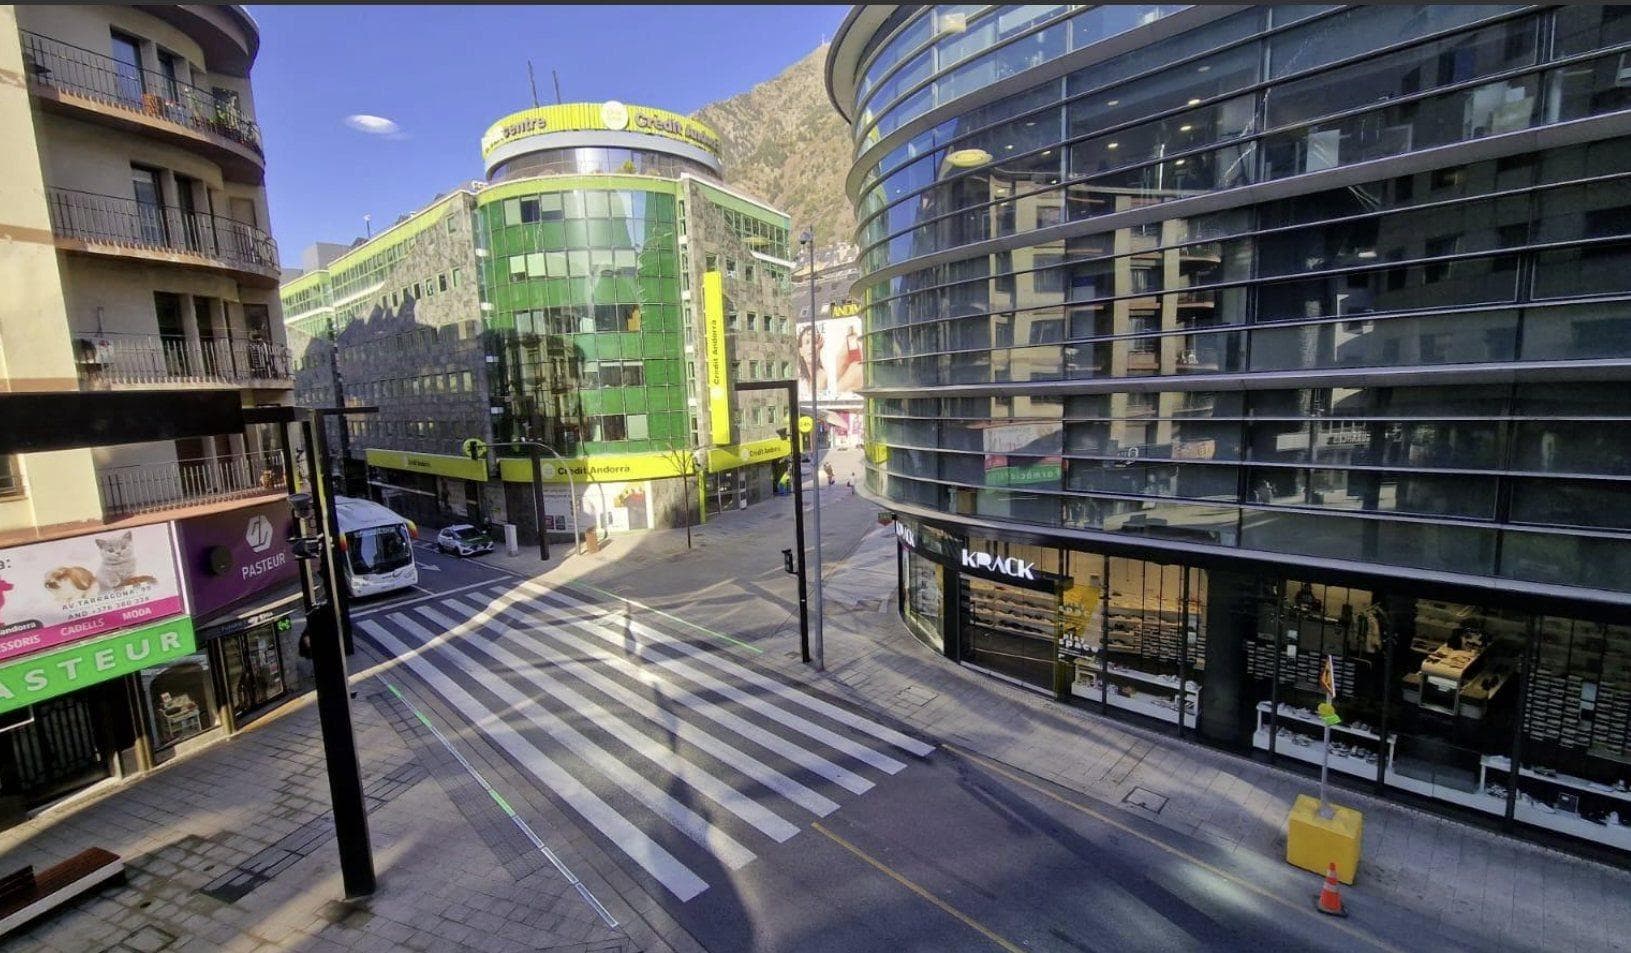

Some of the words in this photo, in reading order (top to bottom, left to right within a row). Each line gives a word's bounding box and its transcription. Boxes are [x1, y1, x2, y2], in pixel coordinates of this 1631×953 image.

[242, 552, 286, 580] PASTEUR
[962, 548, 1034, 580] KRACK
[122, 607, 152, 621] MODA
